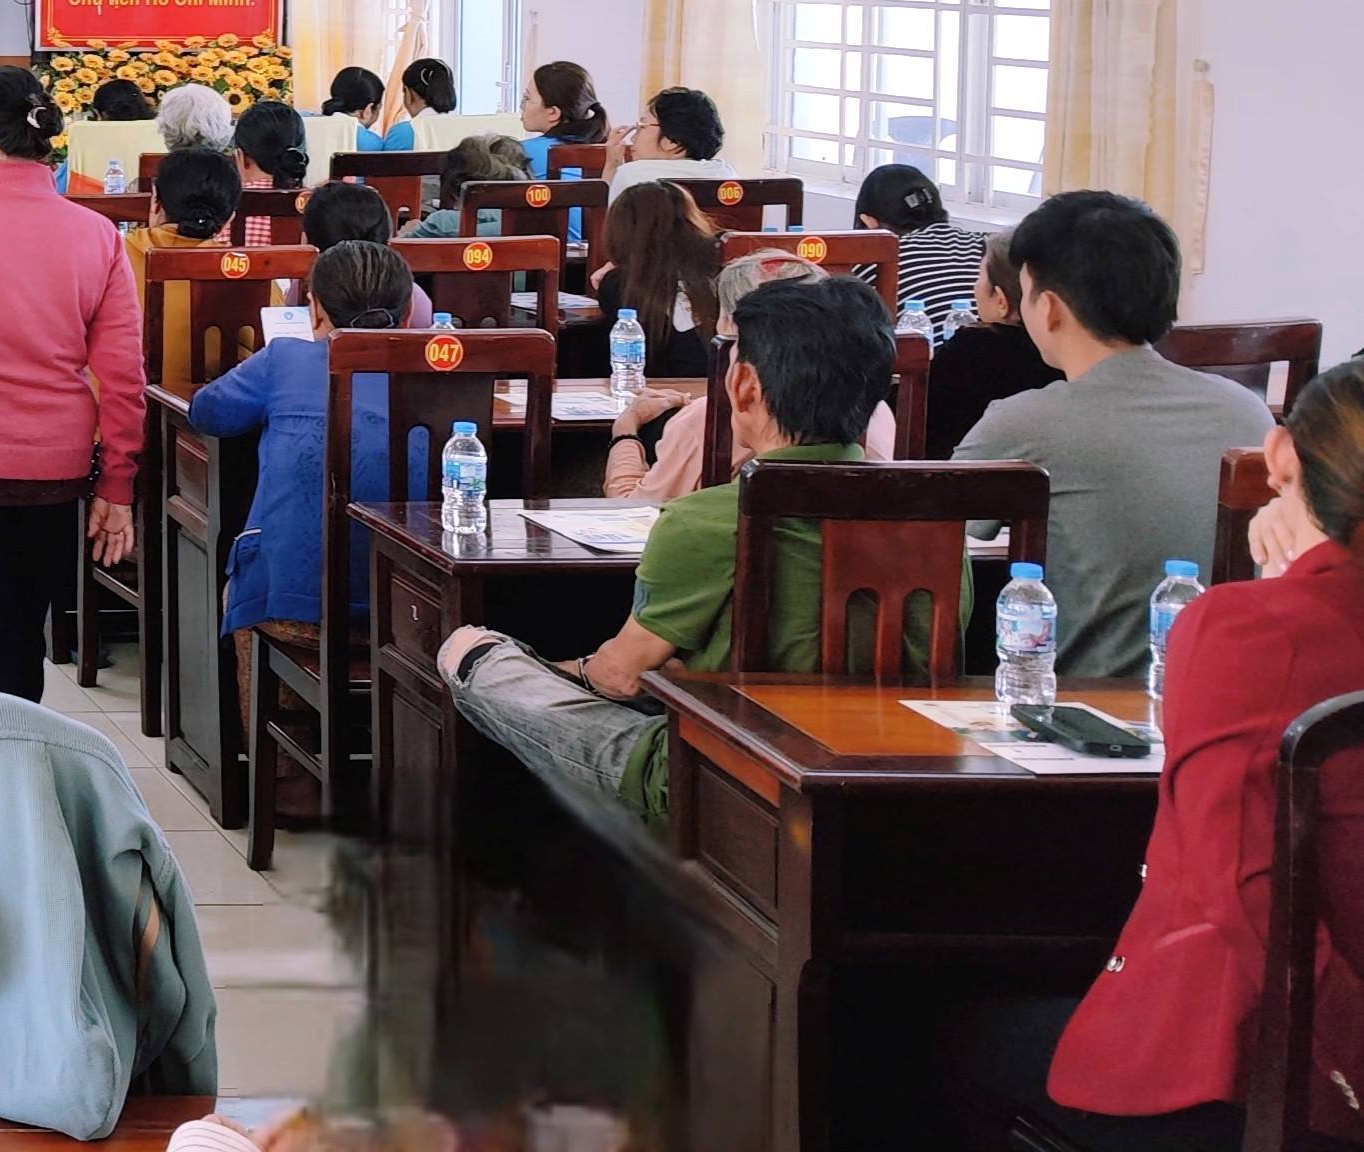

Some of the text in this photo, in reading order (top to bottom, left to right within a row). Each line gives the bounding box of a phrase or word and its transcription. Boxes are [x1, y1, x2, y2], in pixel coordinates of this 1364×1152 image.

[467, 249, 488, 264] 094
[800, 242, 823, 258] 090
[223, 256, 247, 273] 045
[430, 343, 460, 362] 047
